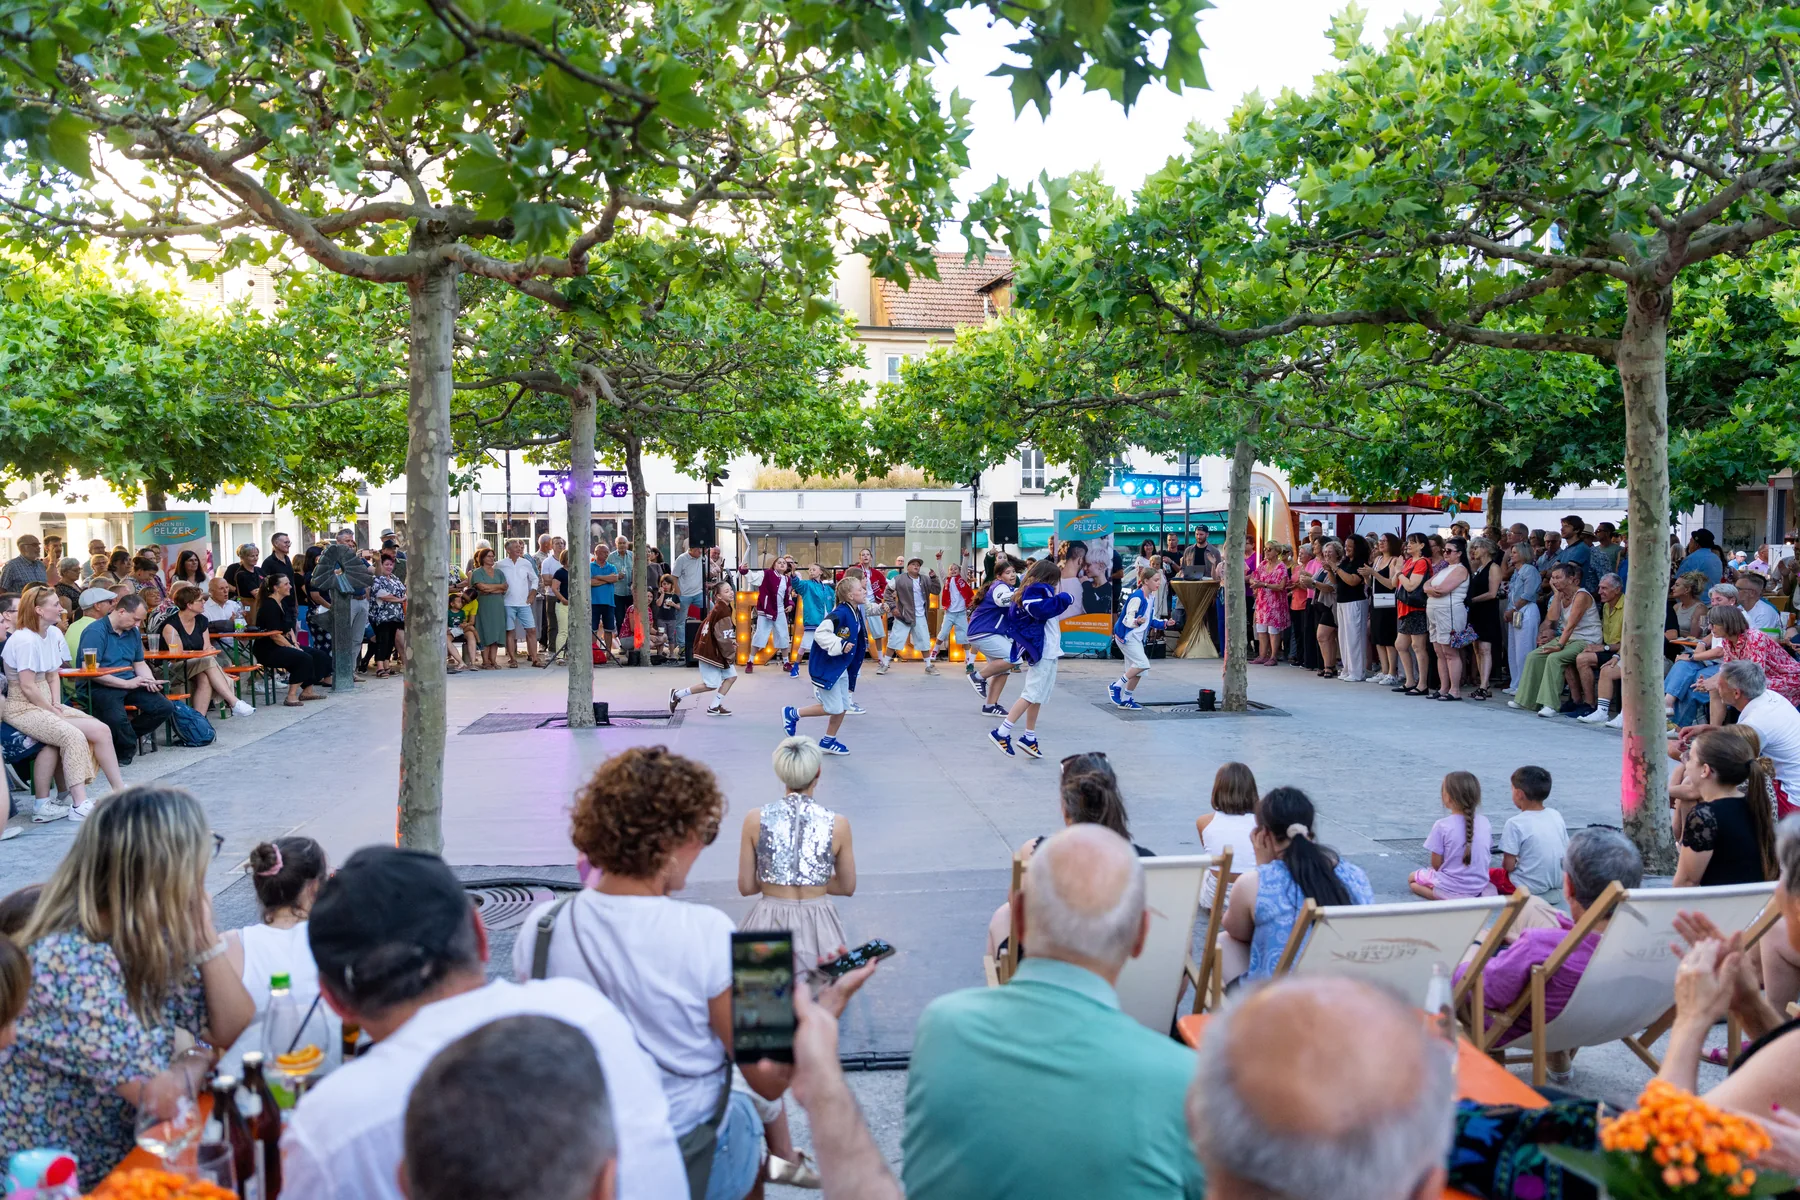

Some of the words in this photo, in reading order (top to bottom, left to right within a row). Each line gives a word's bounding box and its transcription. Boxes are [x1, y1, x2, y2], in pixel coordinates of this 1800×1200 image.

[910, 515, 959, 529] famos.
[154, 526, 195, 536] PELZER
[1073, 523, 1106, 532] PELZER
[1122, 524, 1136, 532] Tee
[1149, 524, 1174, 532] Kafee
